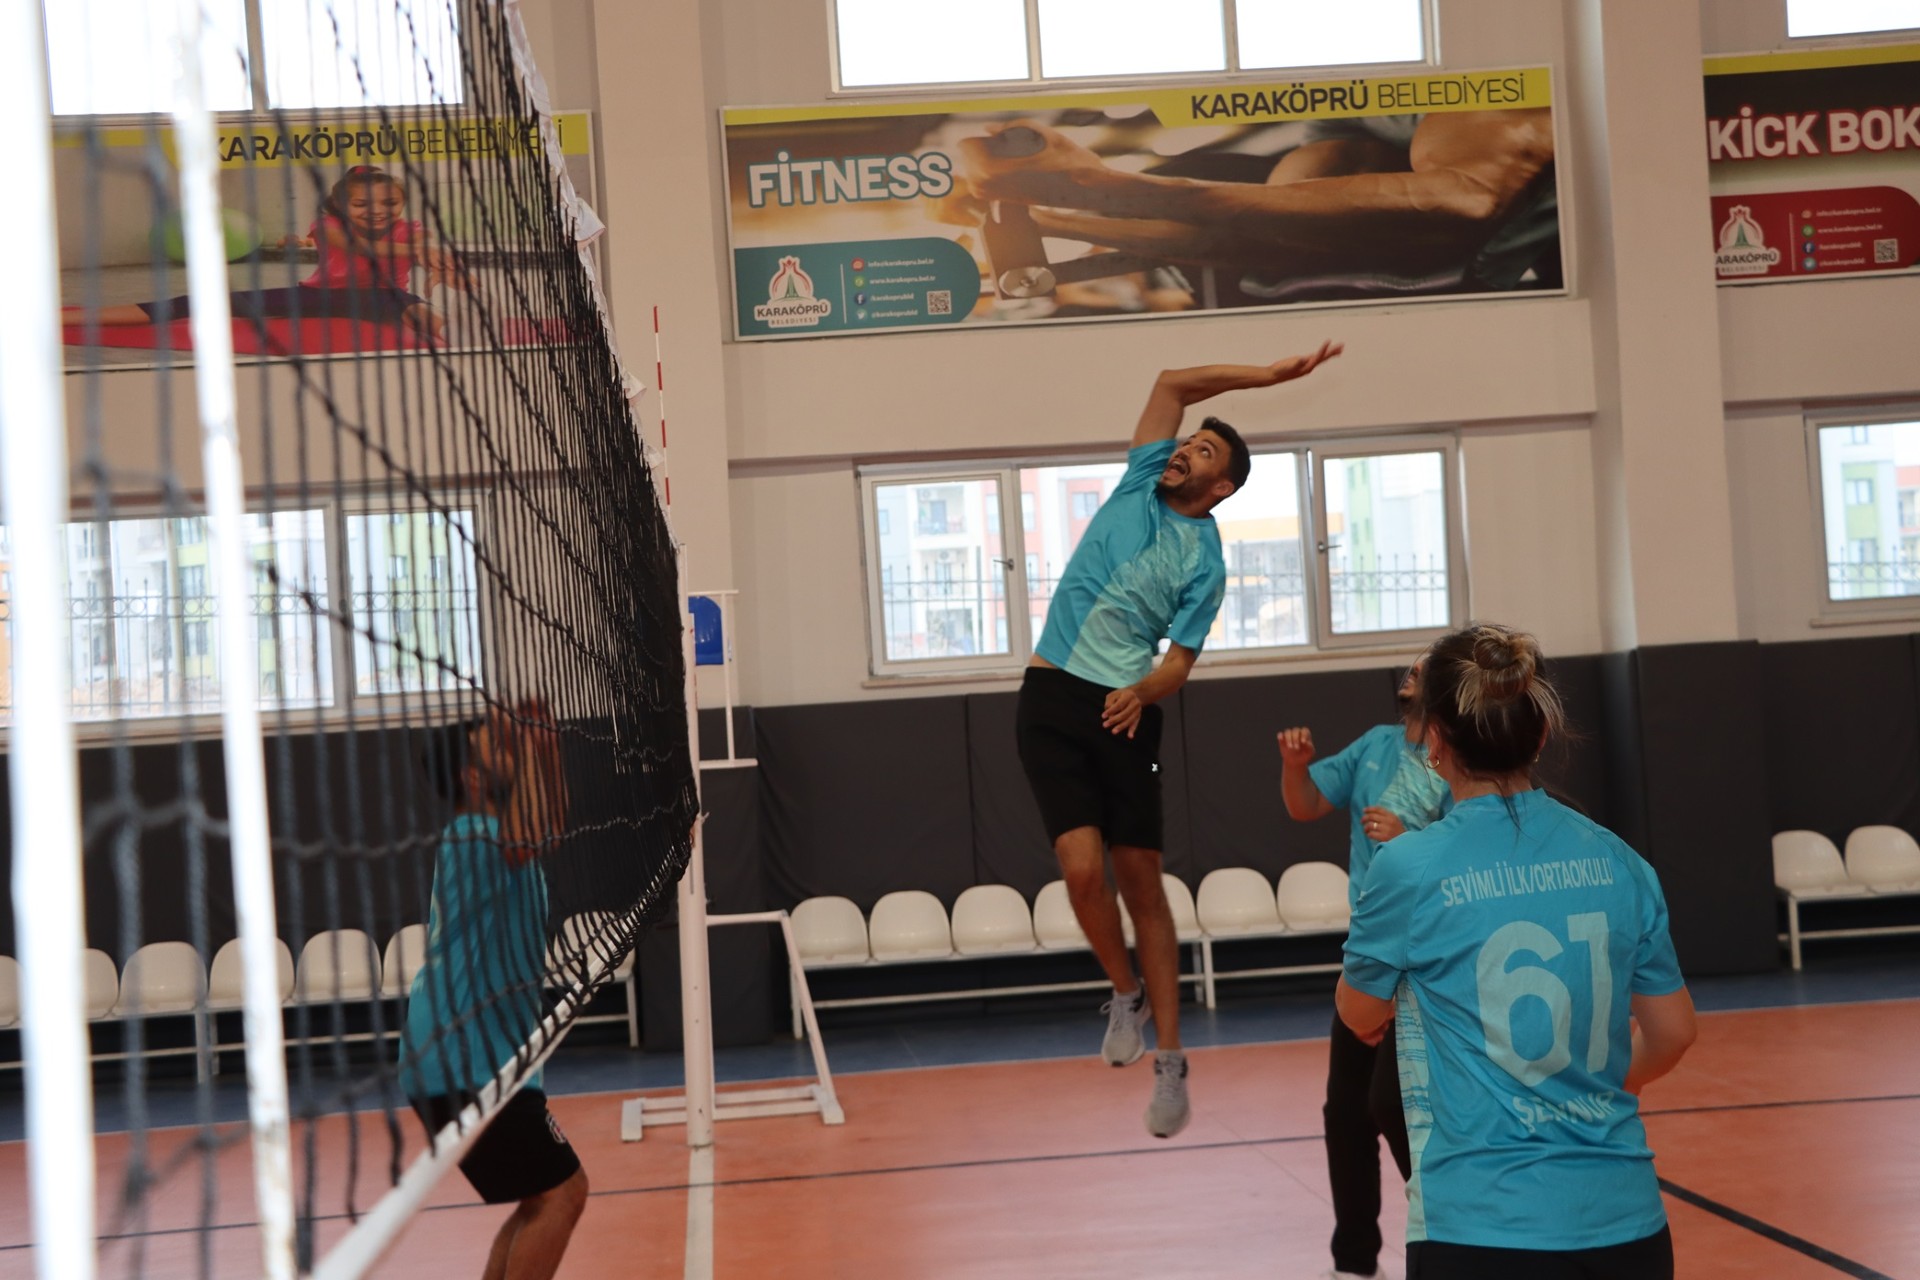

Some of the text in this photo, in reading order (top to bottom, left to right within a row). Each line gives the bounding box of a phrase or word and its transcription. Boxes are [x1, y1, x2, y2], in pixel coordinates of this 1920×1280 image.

[1191, 73, 1525, 119] KARAKÖPRÜ BELEDİYESİ
[408, 119, 563, 154] BELEDİYEİ
[1708, 106, 1820, 160] KİCK
[749, 151, 952, 206] FİTNESS
[1715, 251, 1777, 265] ARAKÖPRÜ
[757, 302, 828, 318] KARAKÖPRÜ
[1441, 861, 1505, 907] SEVİMLİ
[1475, 911, 1613, 1088] 61
